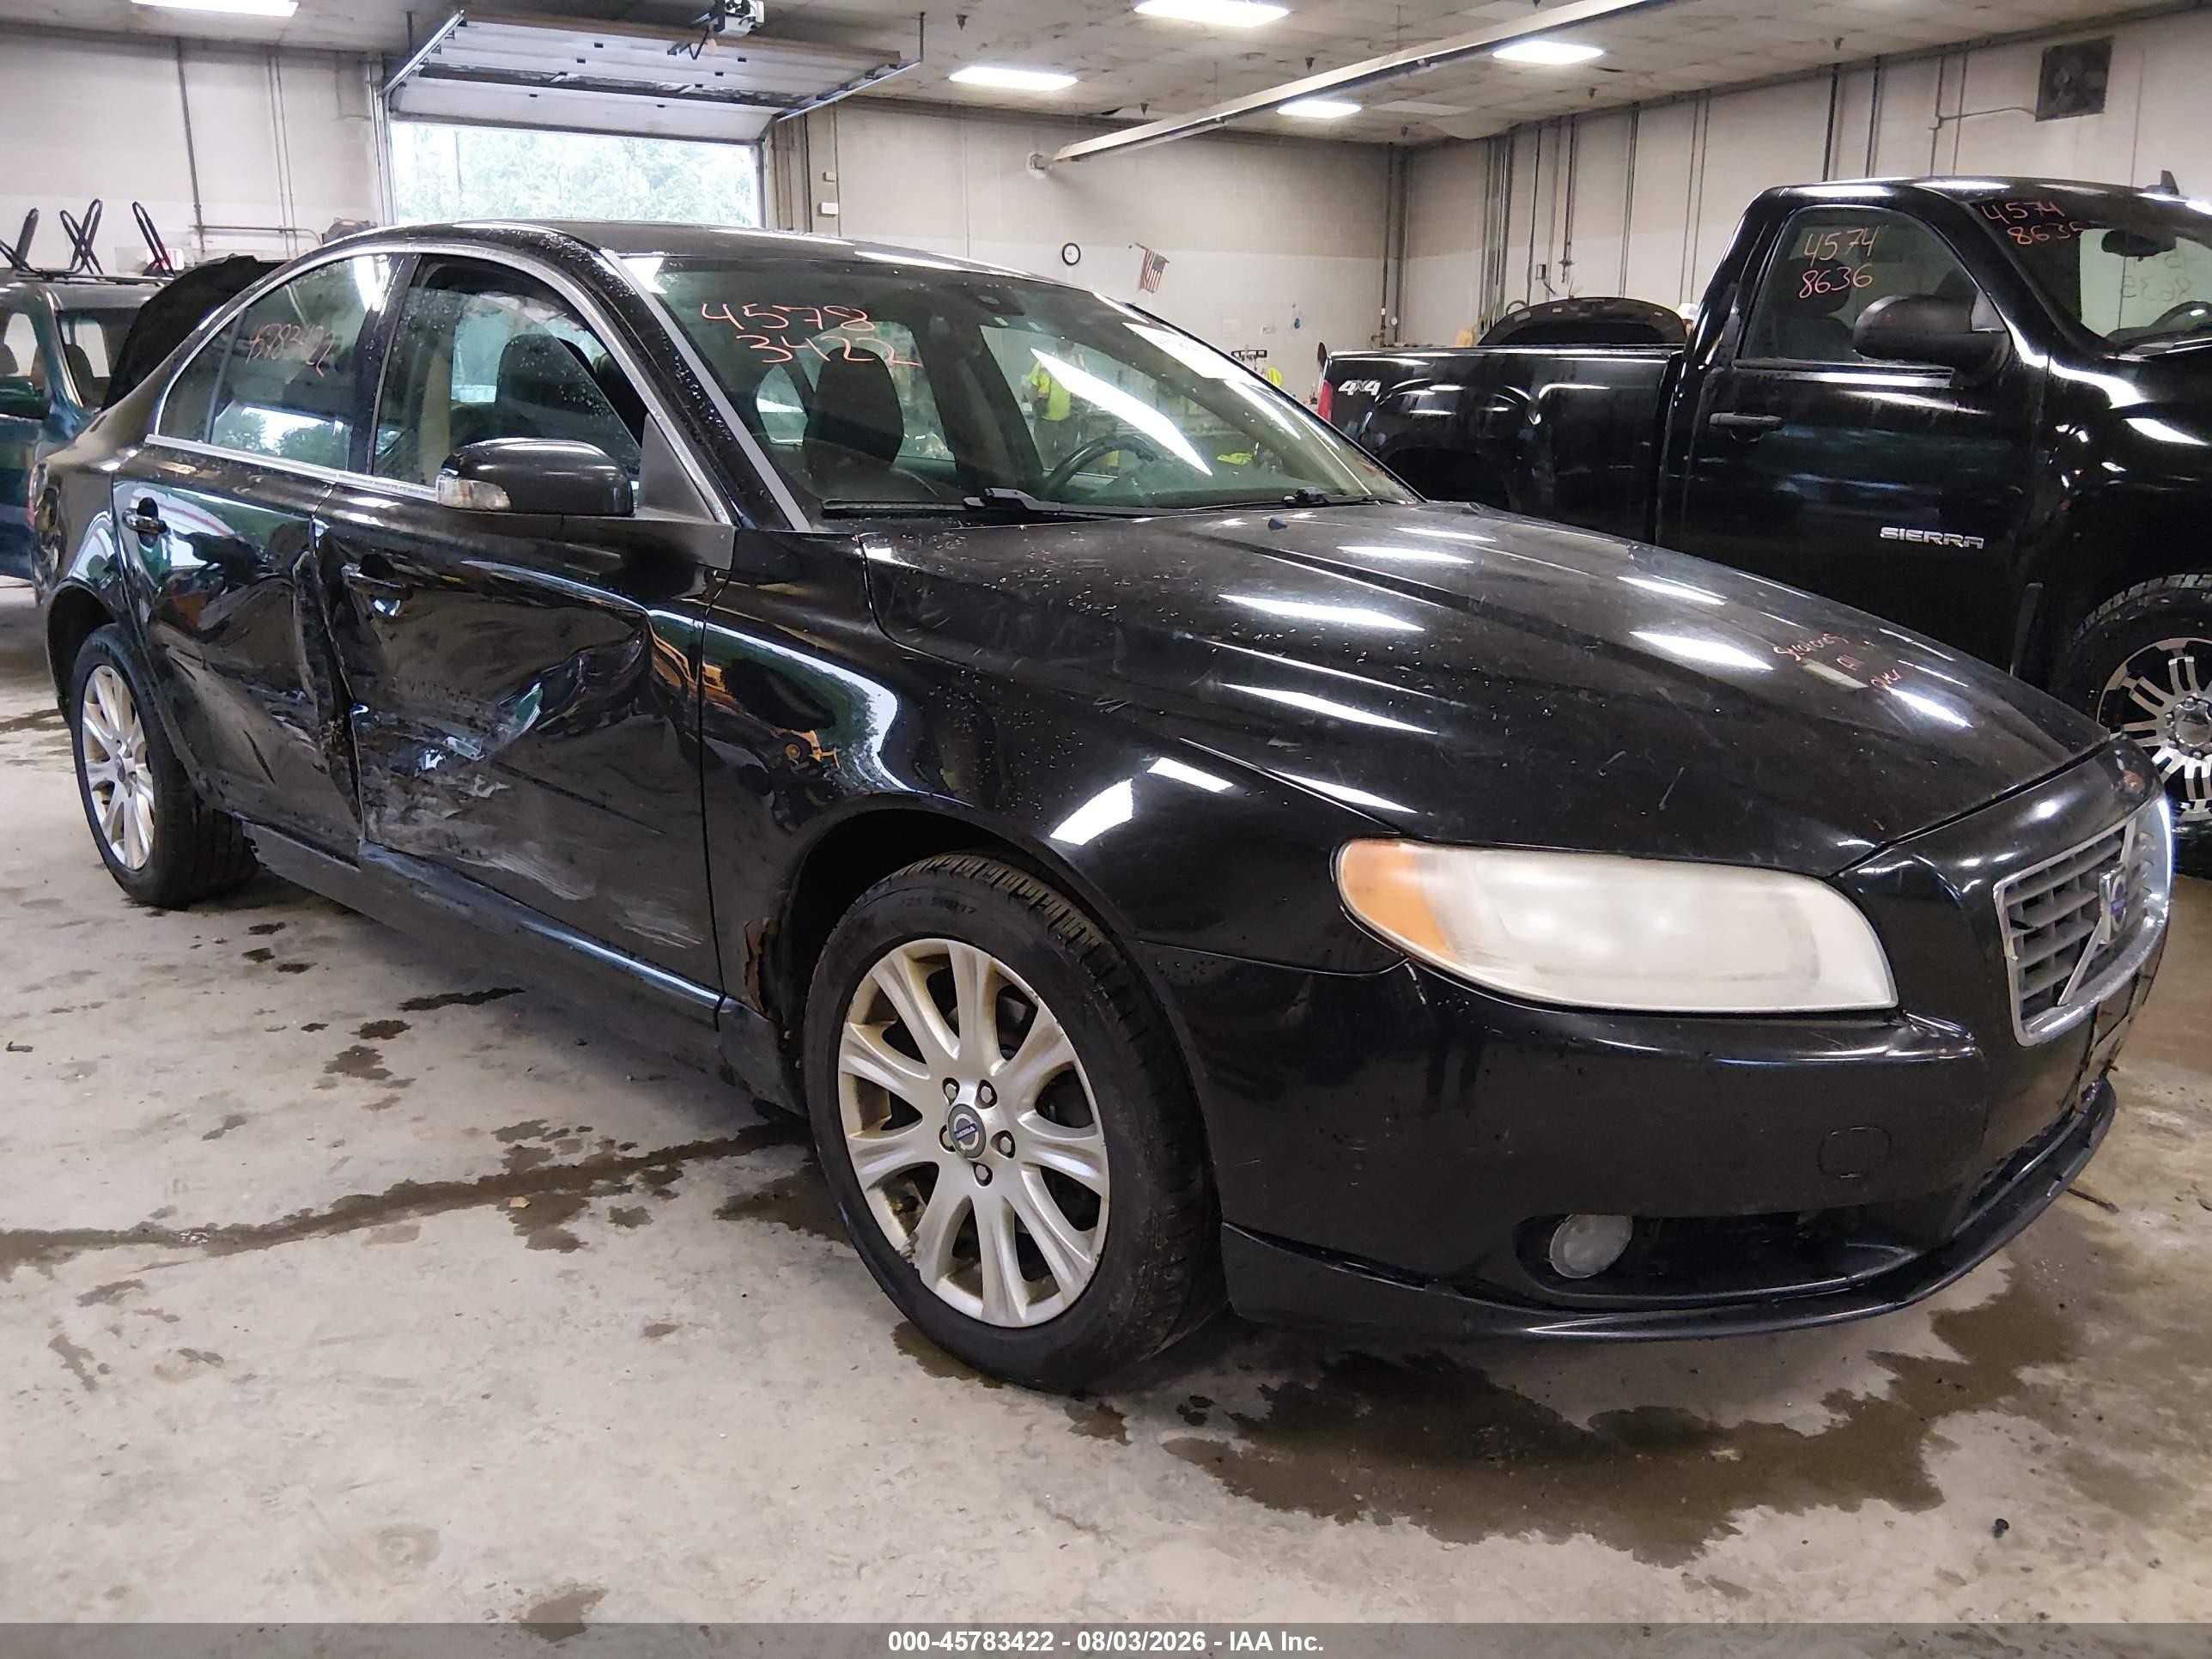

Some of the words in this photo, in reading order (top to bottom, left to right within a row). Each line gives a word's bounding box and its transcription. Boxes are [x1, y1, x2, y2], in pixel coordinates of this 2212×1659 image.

[1981, 200, 2065, 224] 4574
[1804, 226, 1880, 268] 4574
[1799, 264, 1873, 298] 8636
[701, 303, 876, 331] 4578
[736, 334, 922, 363] 3422
[1880, 526, 1984, 550] SIERRA
